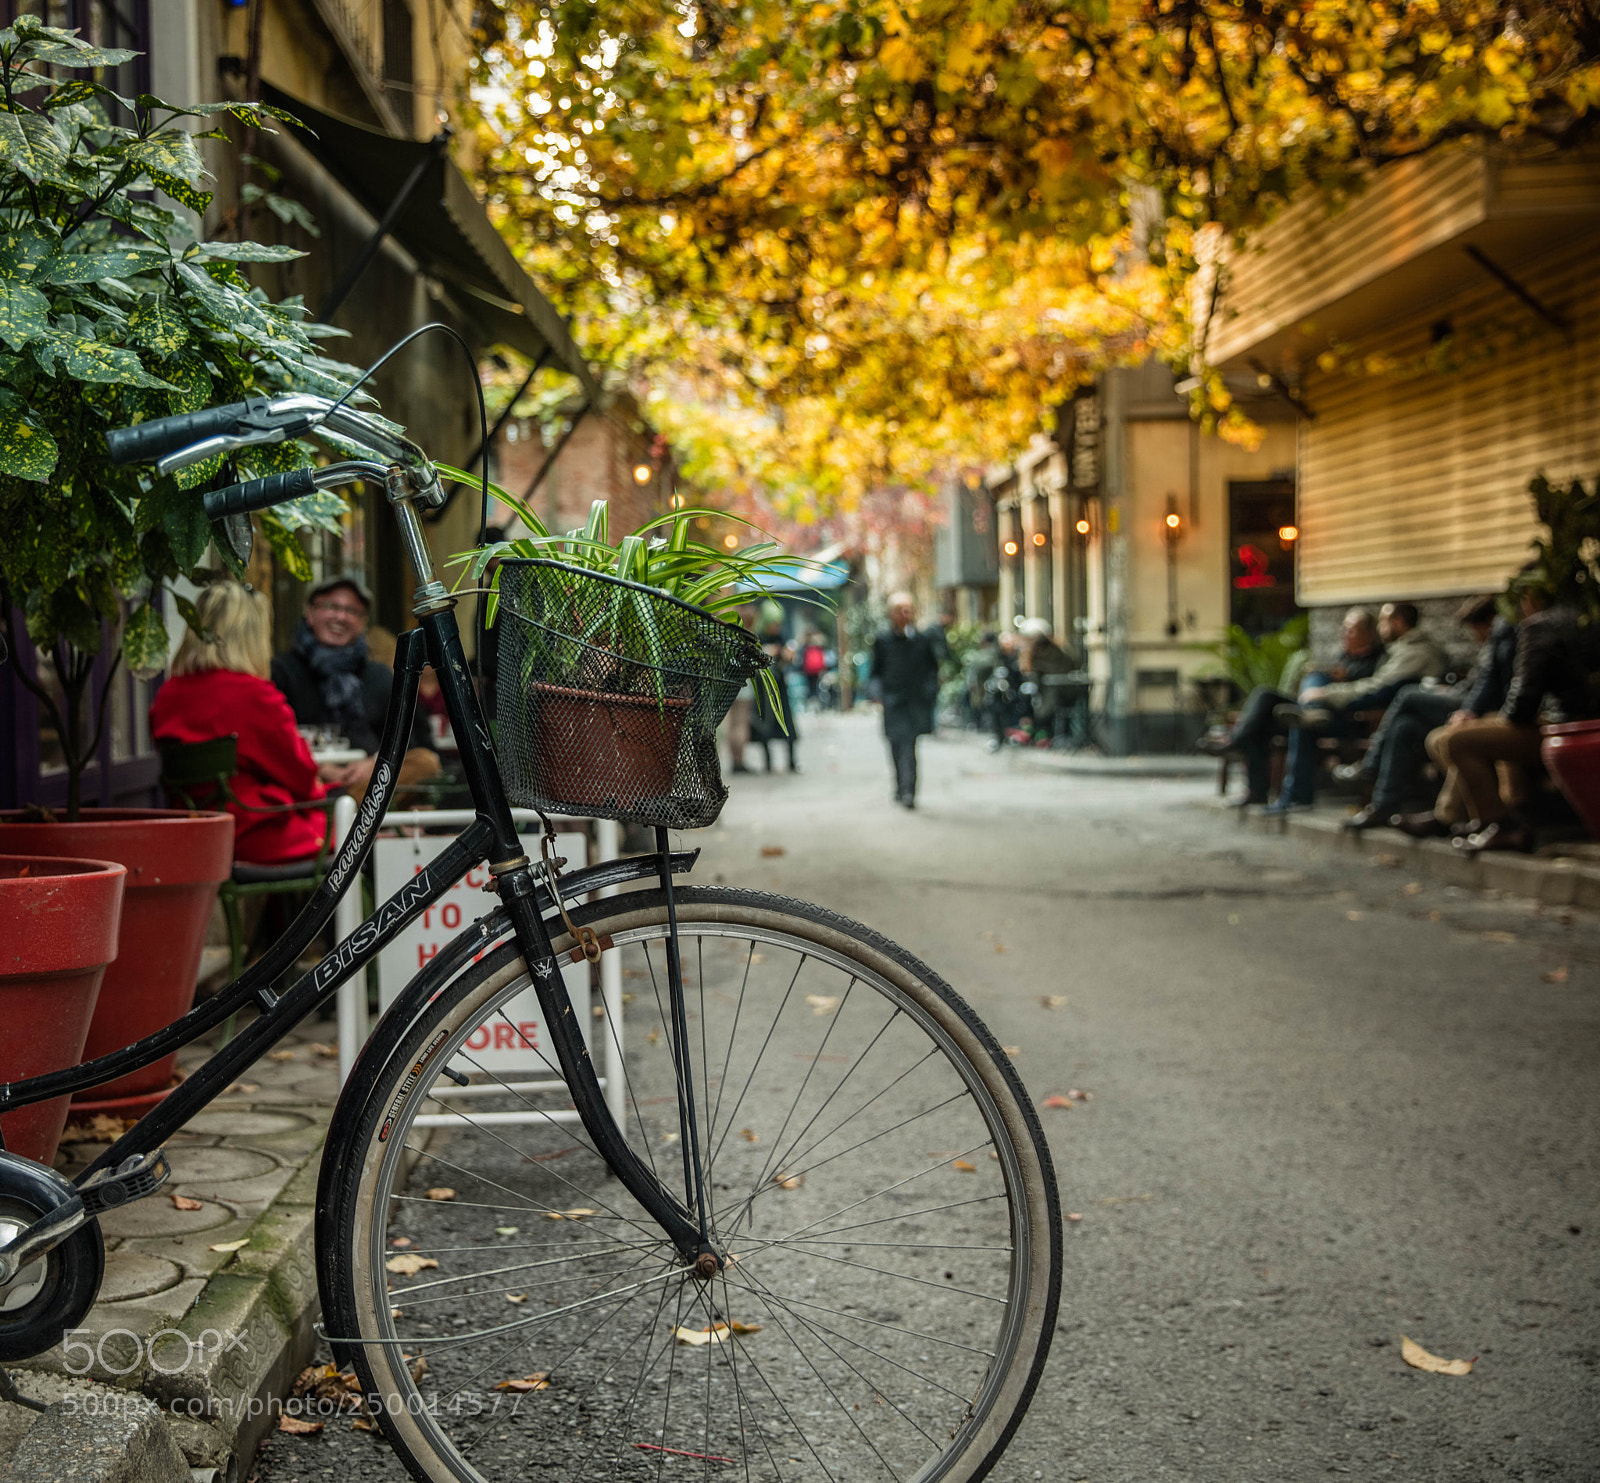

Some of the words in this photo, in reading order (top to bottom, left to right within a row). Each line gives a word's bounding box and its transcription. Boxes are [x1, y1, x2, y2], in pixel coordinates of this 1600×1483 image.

[328, 763, 391, 893] paradise
[420, 903, 462, 930] TO
[464, 1020, 539, 1051] ORE
[388, 1091, 407, 1119] GENERAL
[402, 1073, 417, 1093] STYLE
